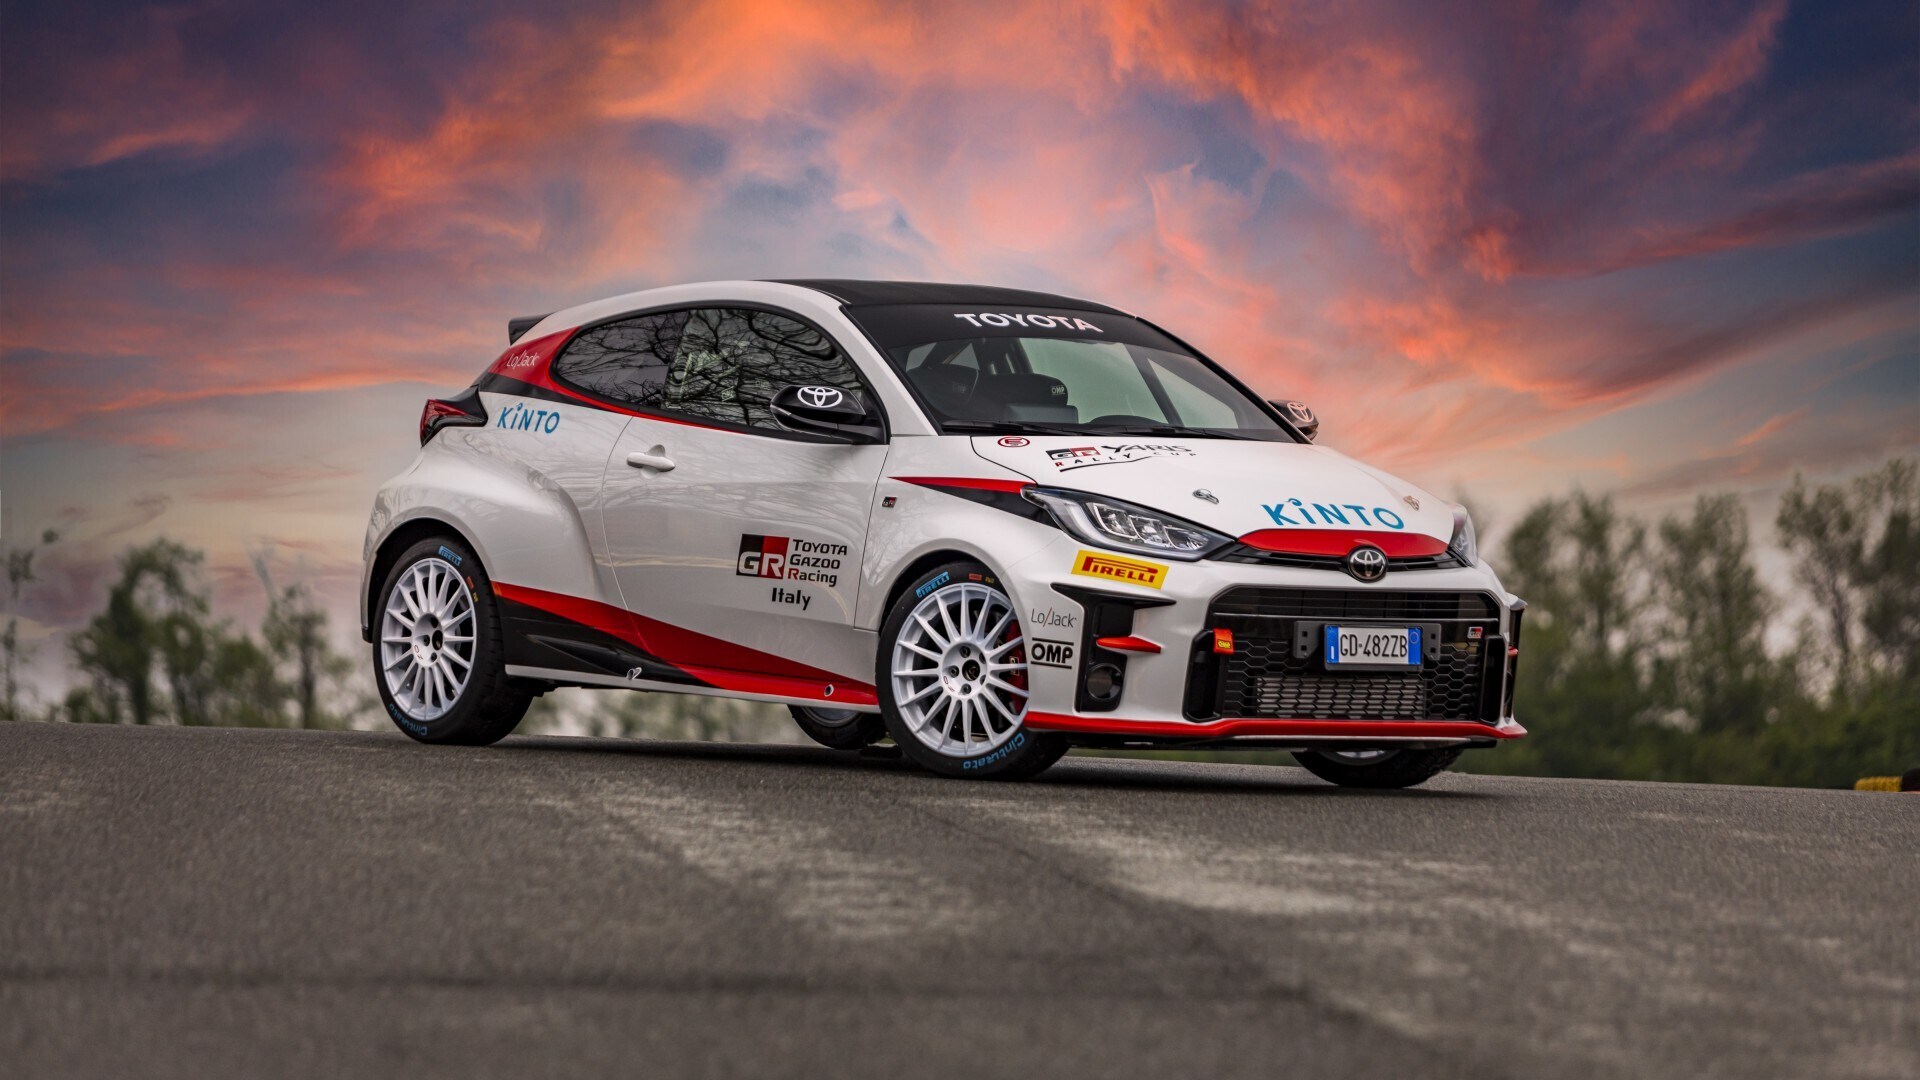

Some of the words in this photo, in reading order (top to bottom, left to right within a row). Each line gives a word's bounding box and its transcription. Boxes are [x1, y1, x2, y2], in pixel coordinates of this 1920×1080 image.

[953, 312, 1105, 333] TOYOTA
[1101, 444, 1192, 454] YARIS
[1055, 453, 1132, 467] RALLY
[792, 538, 848, 556] TOYOTA
[737, 551, 786, 578] GR
[789, 553, 841, 570] GAZOO
[1081, 556, 1159, 583] PIRELLI
[787, 567, 838, 587] Racing
[915, 571, 950, 598] PIRELLI
[771, 587, 811, 611] Italy
[1031, 643, 1074, 664] OMP
[963, 732, 1026, 770] Cinturato
